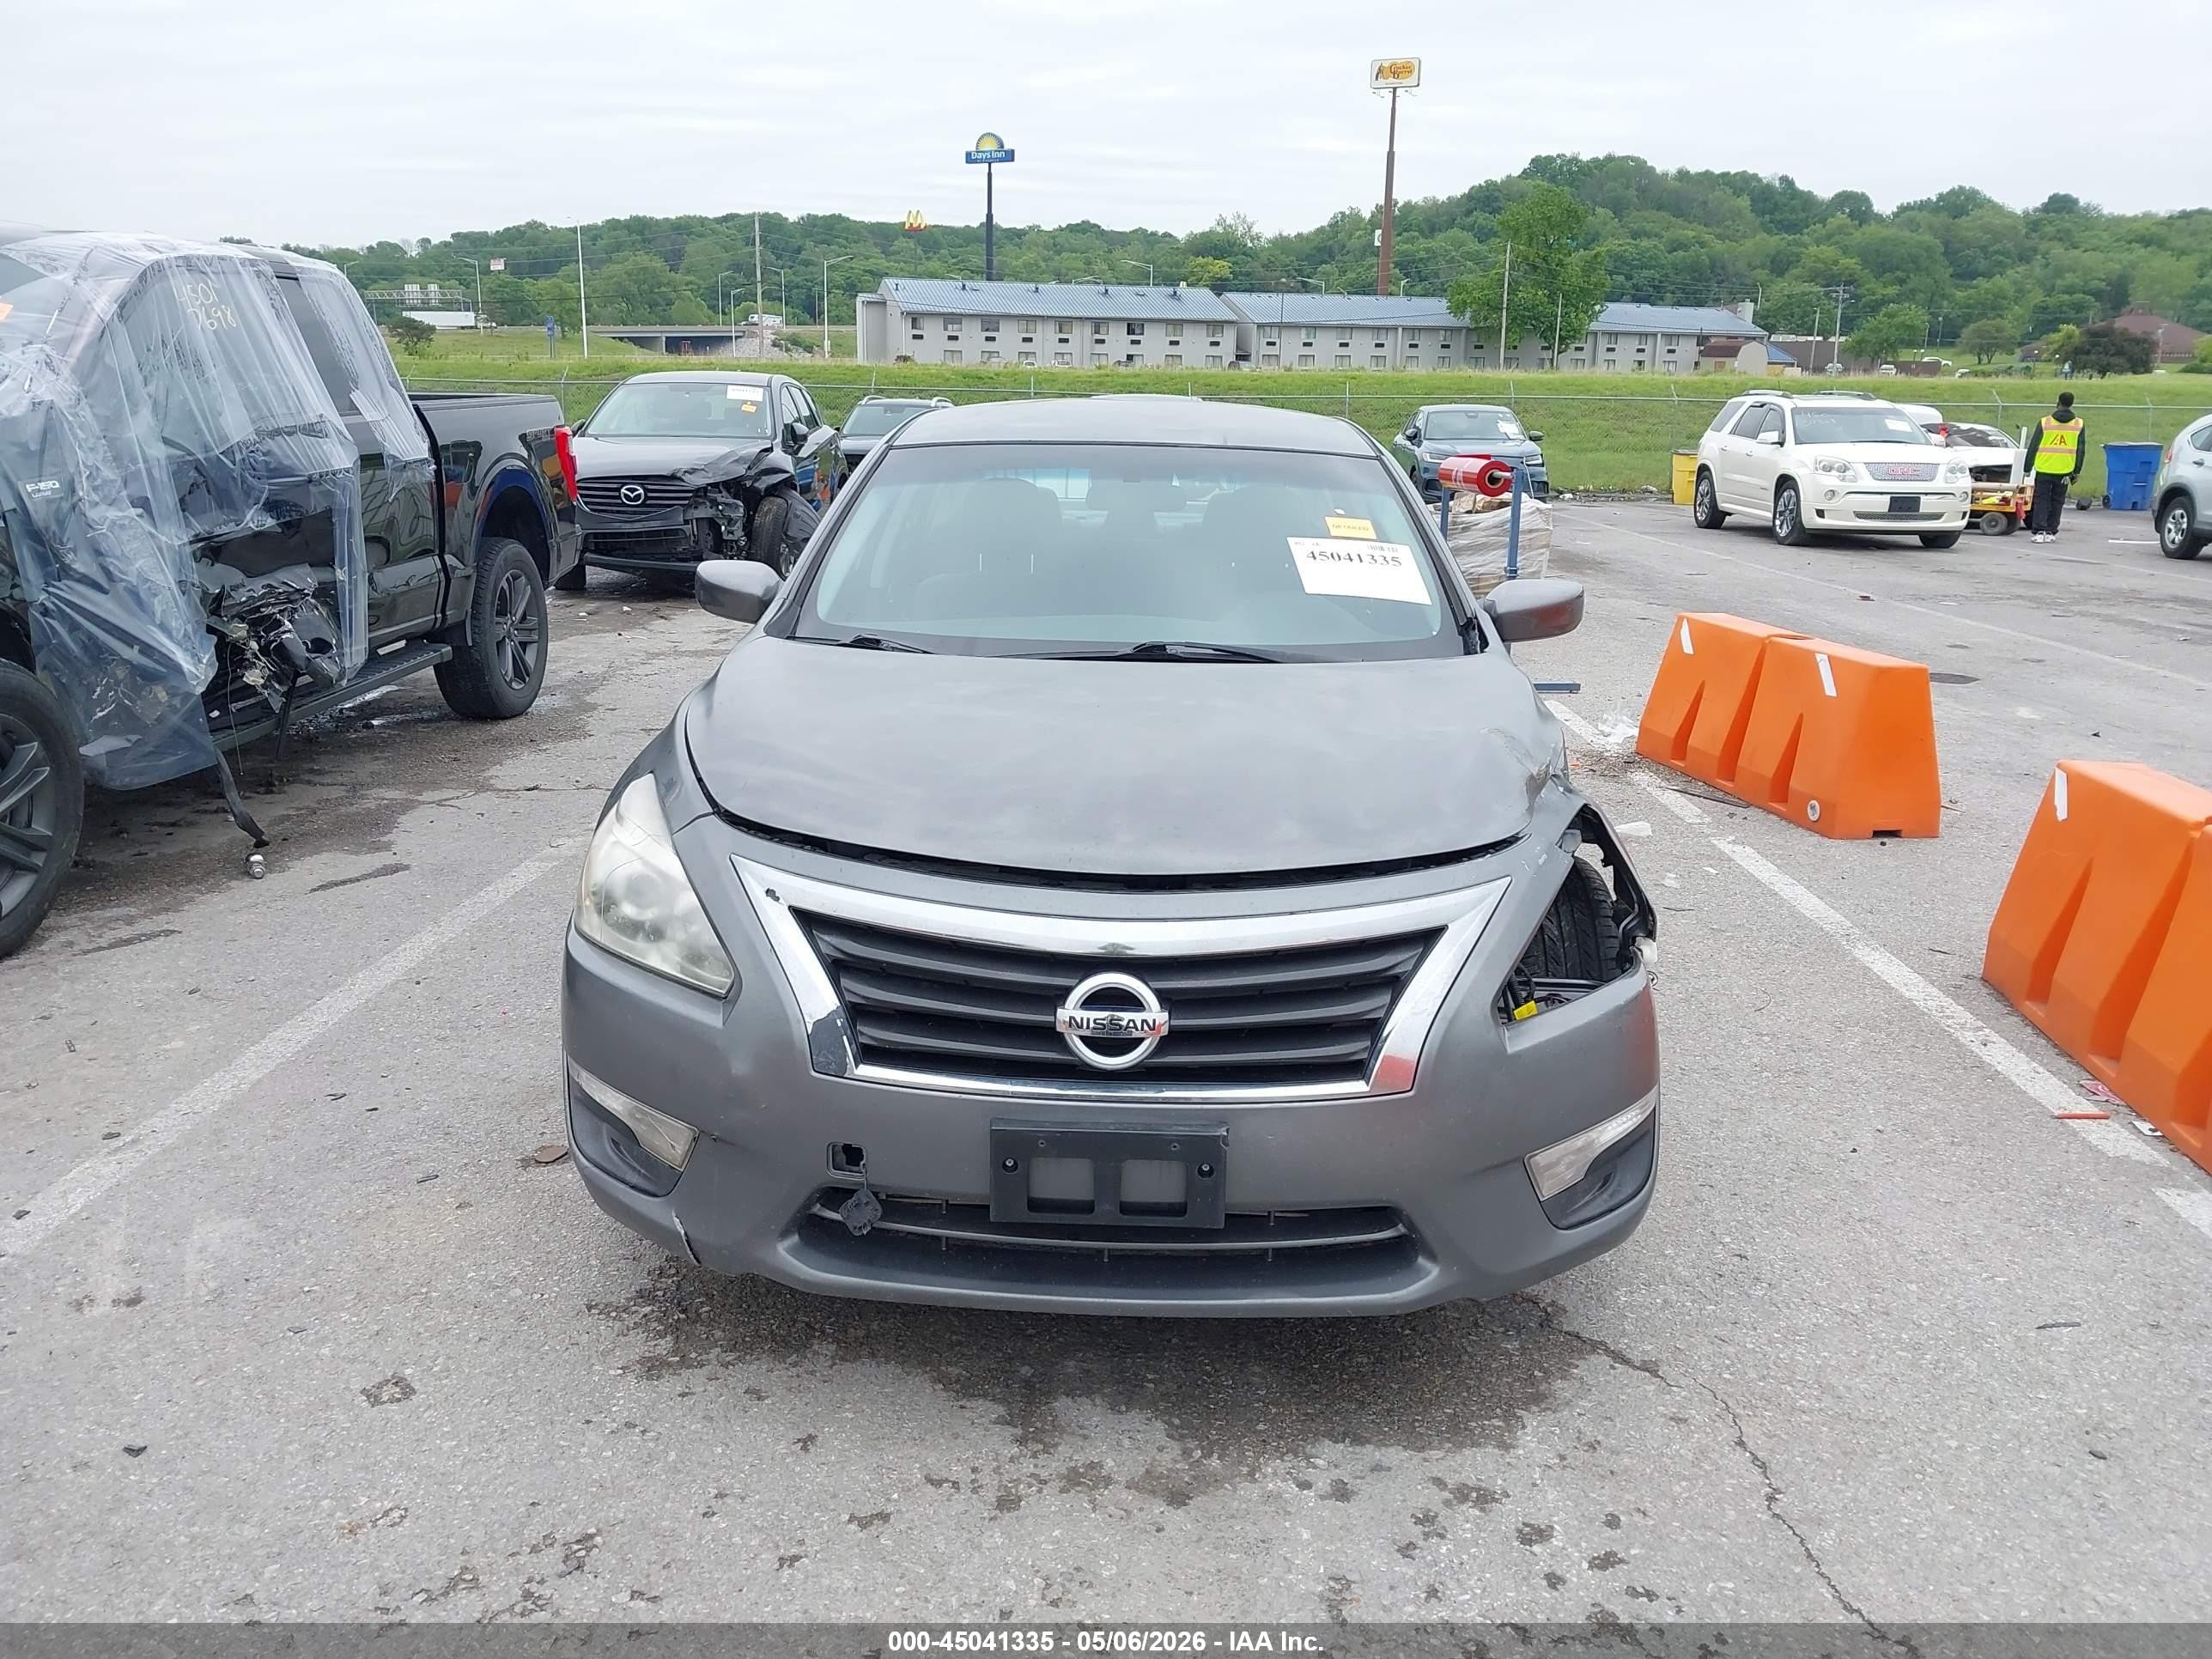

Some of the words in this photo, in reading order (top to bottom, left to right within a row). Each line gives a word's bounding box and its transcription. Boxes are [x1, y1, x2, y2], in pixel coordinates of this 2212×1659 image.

[971, 151, 991, 160] Days
[992, 150, 1006, 159] Inn
[1306, 550, 1402, 567] 45041335
[1067, 1015, 1157, 1032] NISSAN
